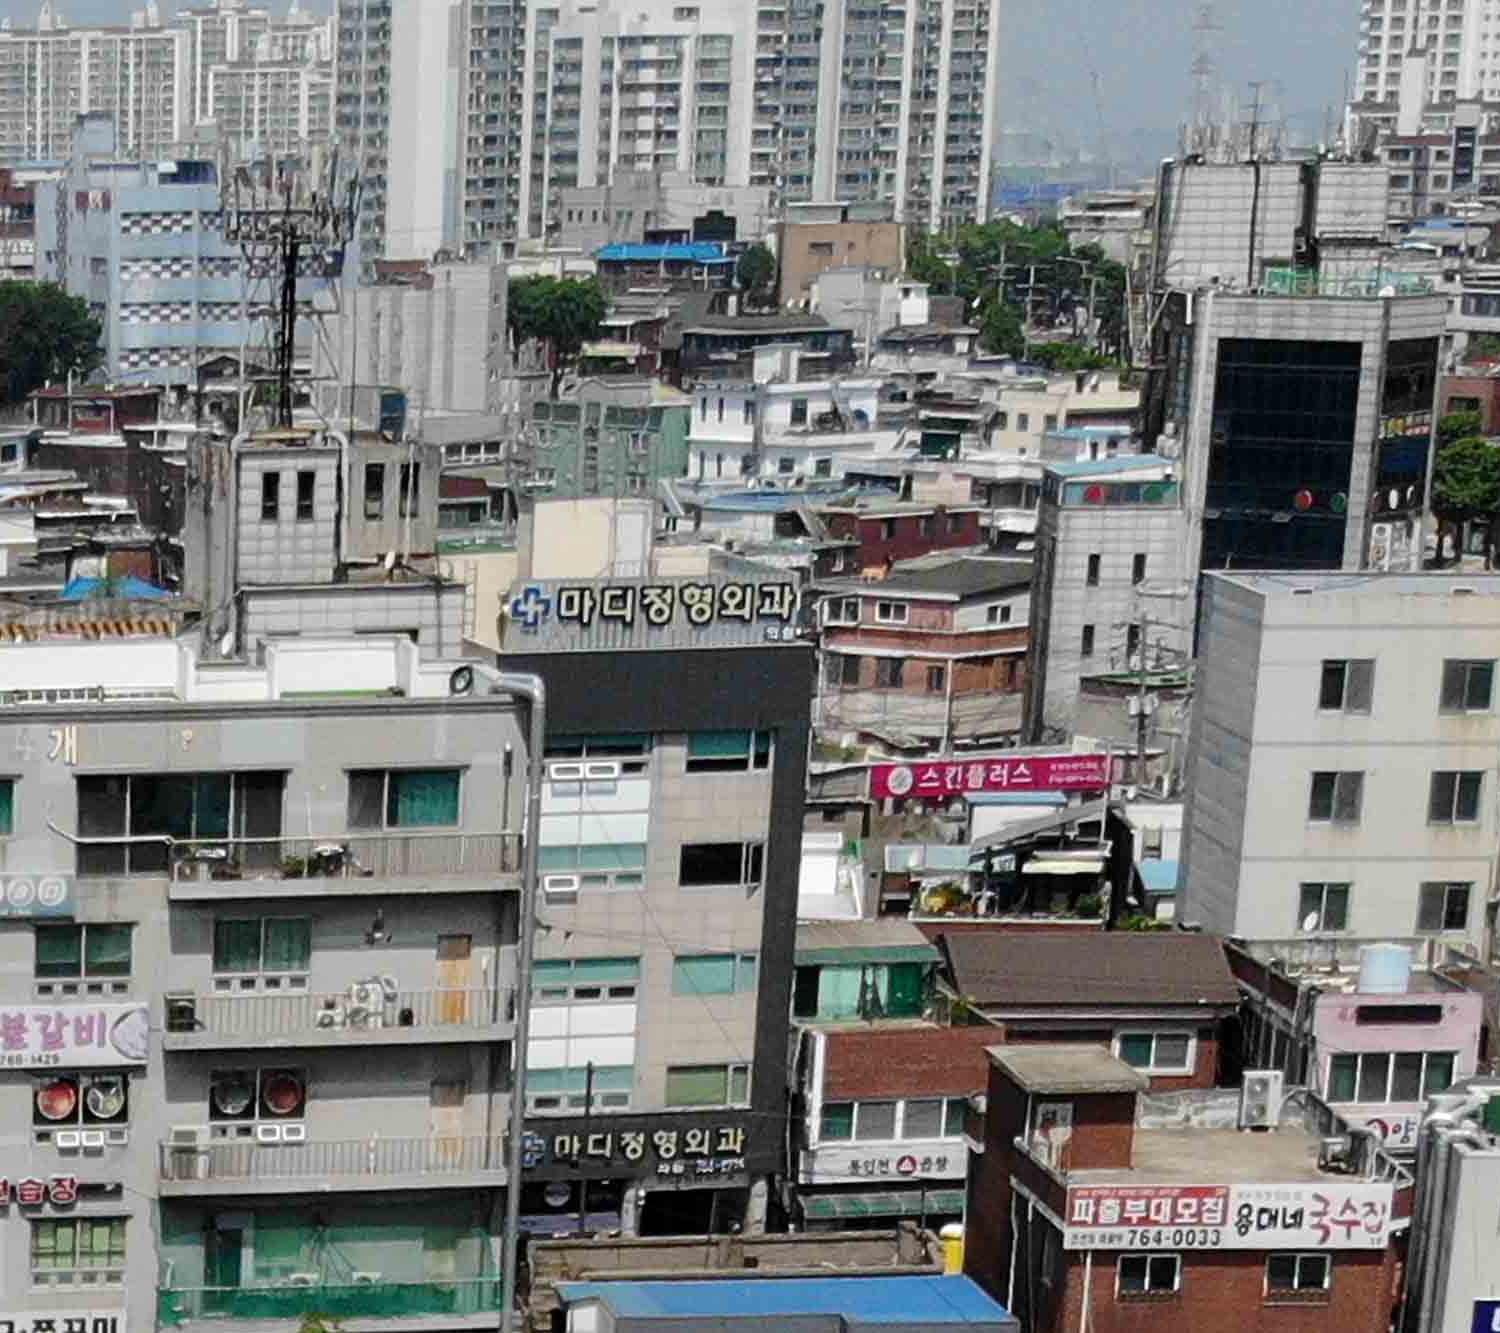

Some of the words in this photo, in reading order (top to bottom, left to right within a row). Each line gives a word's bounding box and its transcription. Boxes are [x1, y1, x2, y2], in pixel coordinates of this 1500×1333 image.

[556, 583, 799, 629] 마디정형외과
[553, 1127, 747, 1159] 마디정형외과
[1128, 1229, 1221, 1246] 764-0033
